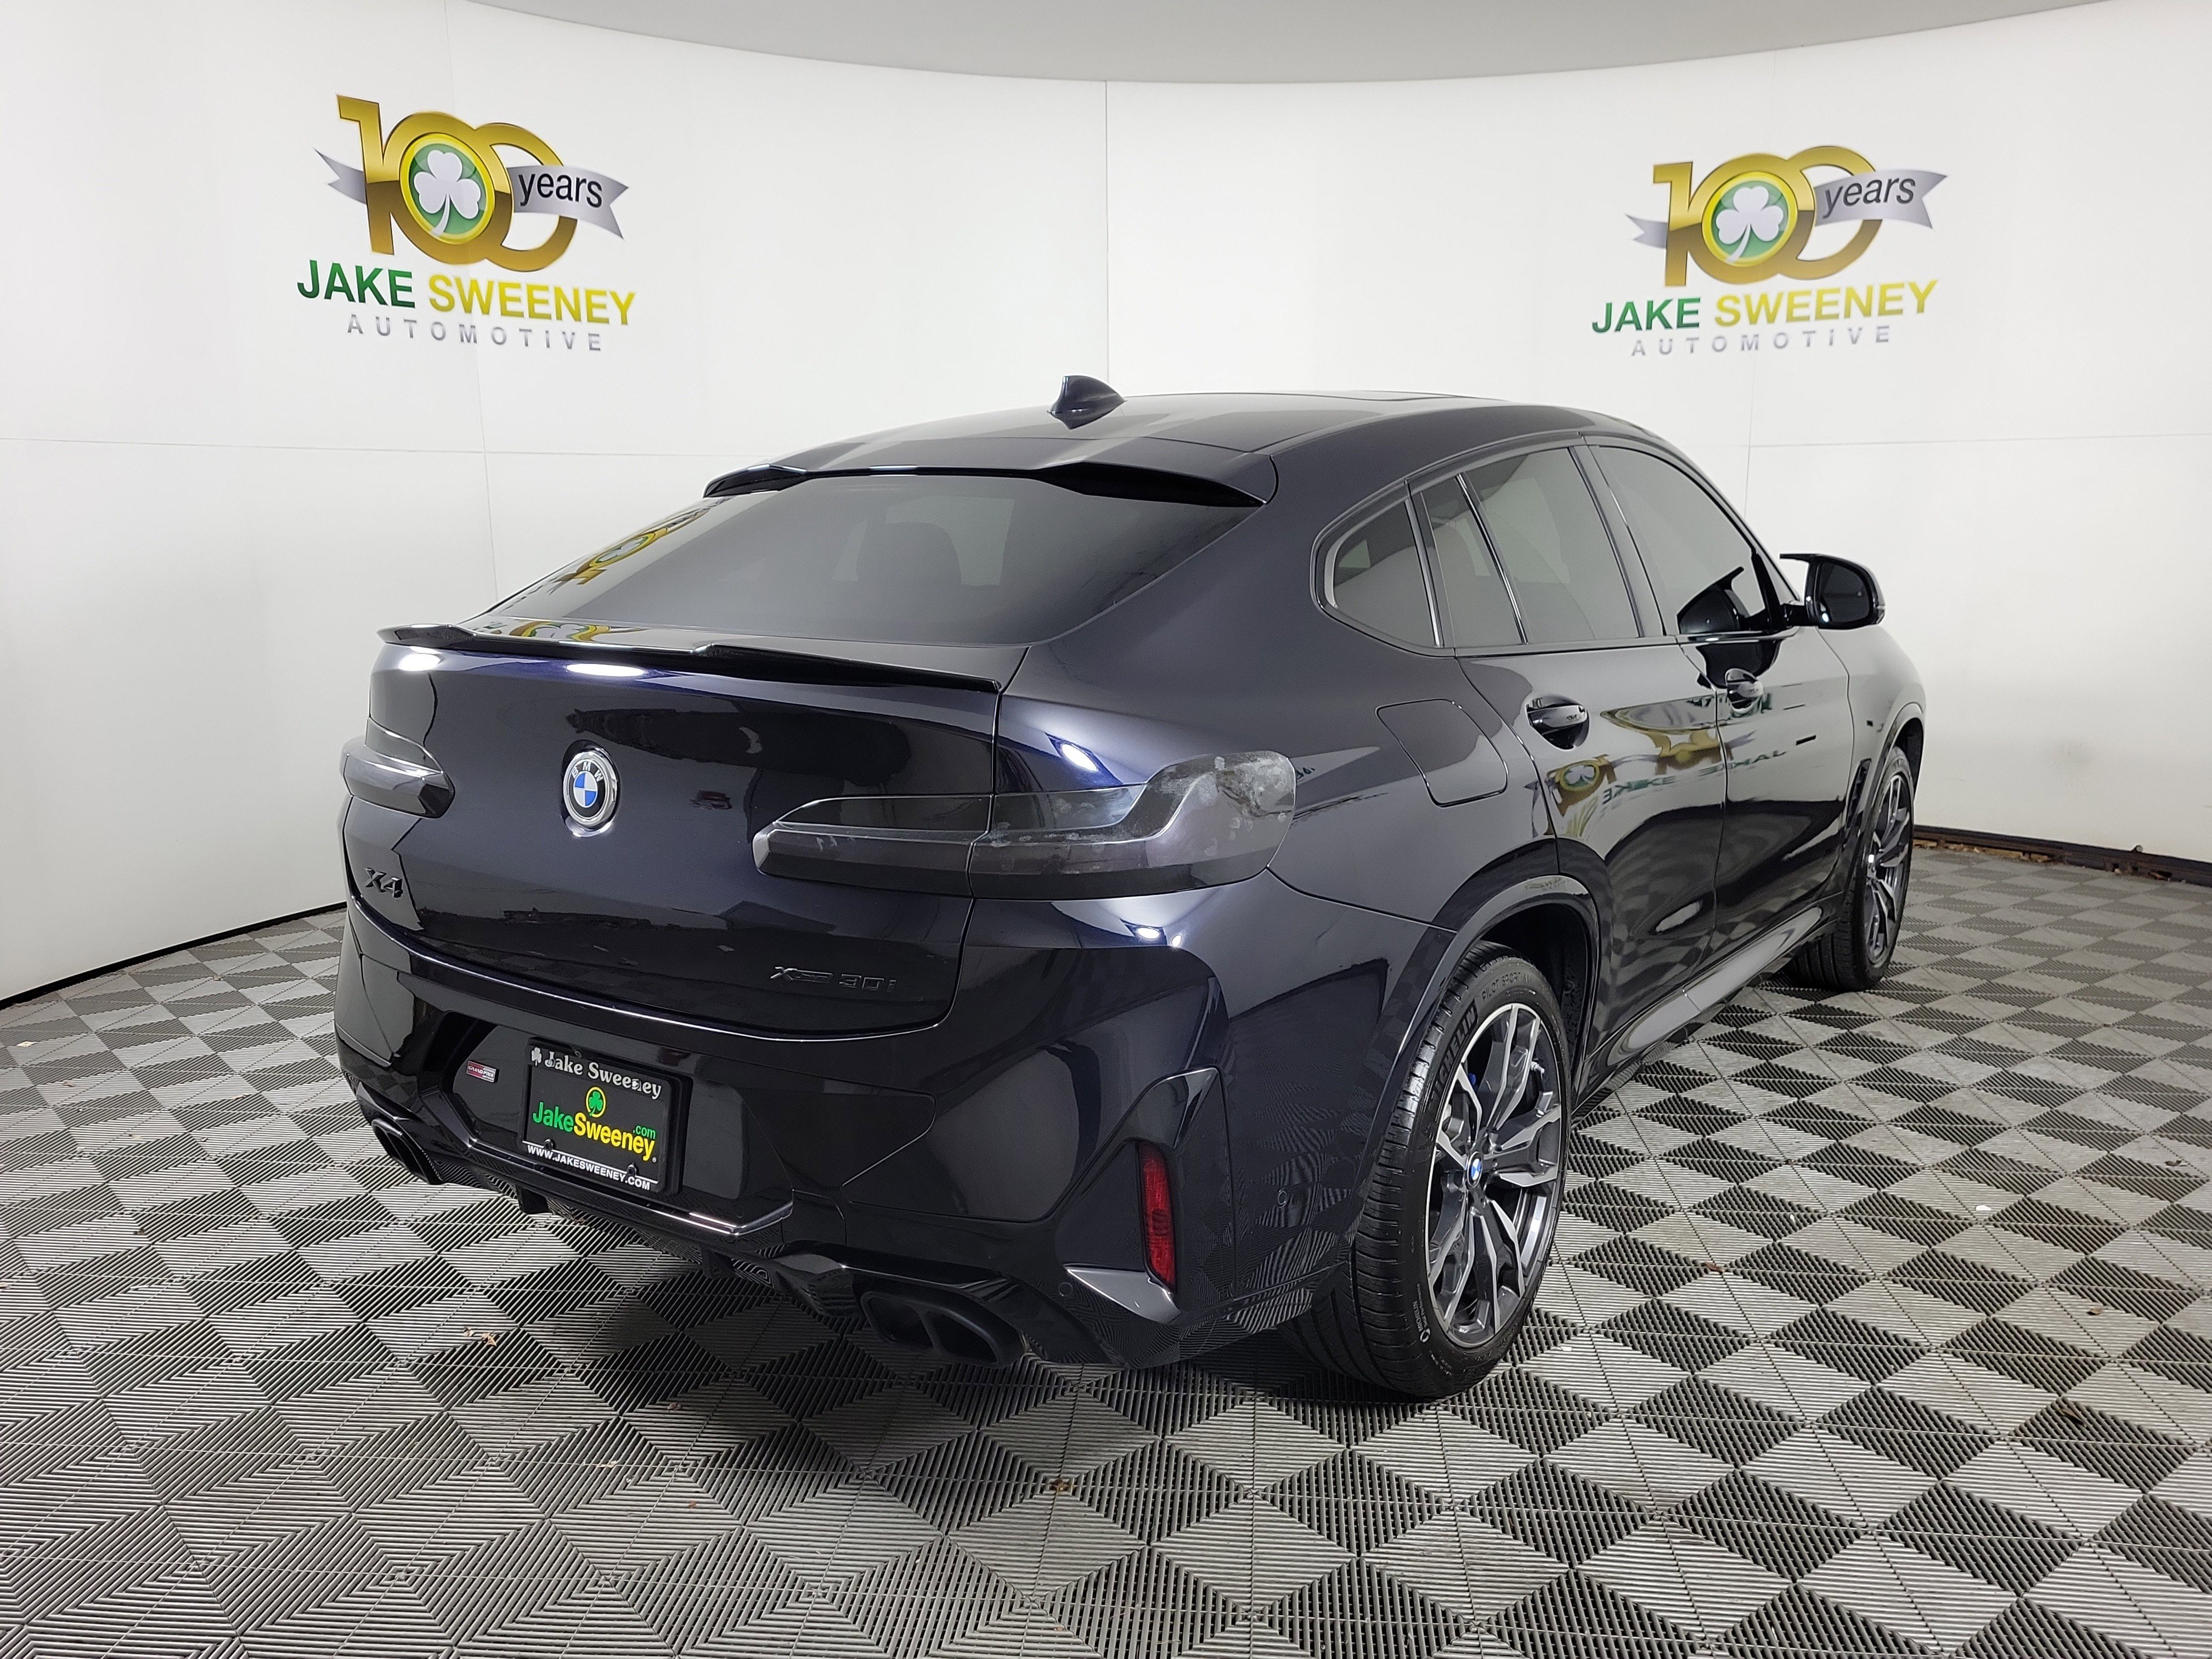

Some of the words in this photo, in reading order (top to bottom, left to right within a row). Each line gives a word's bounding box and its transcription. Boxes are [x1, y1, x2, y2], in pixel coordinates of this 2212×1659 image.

[336, 94, 577, 272] 100
[518, 172, 602, 208] years
[1653, 145, 1882, 287] 100
[1822, 174, 1915, 218] years
[297, 259, 415, 308] JAKE
[428, 274, 635, 325] SWEENEY
[1592, 297, 1701, 334] JAKE
[1714, 280, 1939, 327] SWEENEY
[347, 314, 601, 351] AUTOMOTIVE
[1632, 325, 1890, 357] AUTOMOTIVE
[571, 761, 603, 782] BMW
[364, 867, 403, 898] X4
[1482, 979, 1499, 1000] PILOT
[1502, 972, 1521, 986] SPORT
[545, 1051, 583, 1075] Jake
[588, 1062, 662, 1099] Sweeney
[533, 1102, 654, 1161] JakeSweeney
[633, 1125, 656, 1139] .com
[528, 1144, 650, 1190] WWW.JAKESWEENEY.COM
[1413, 1301, 1423, 1332] MICHELIN
